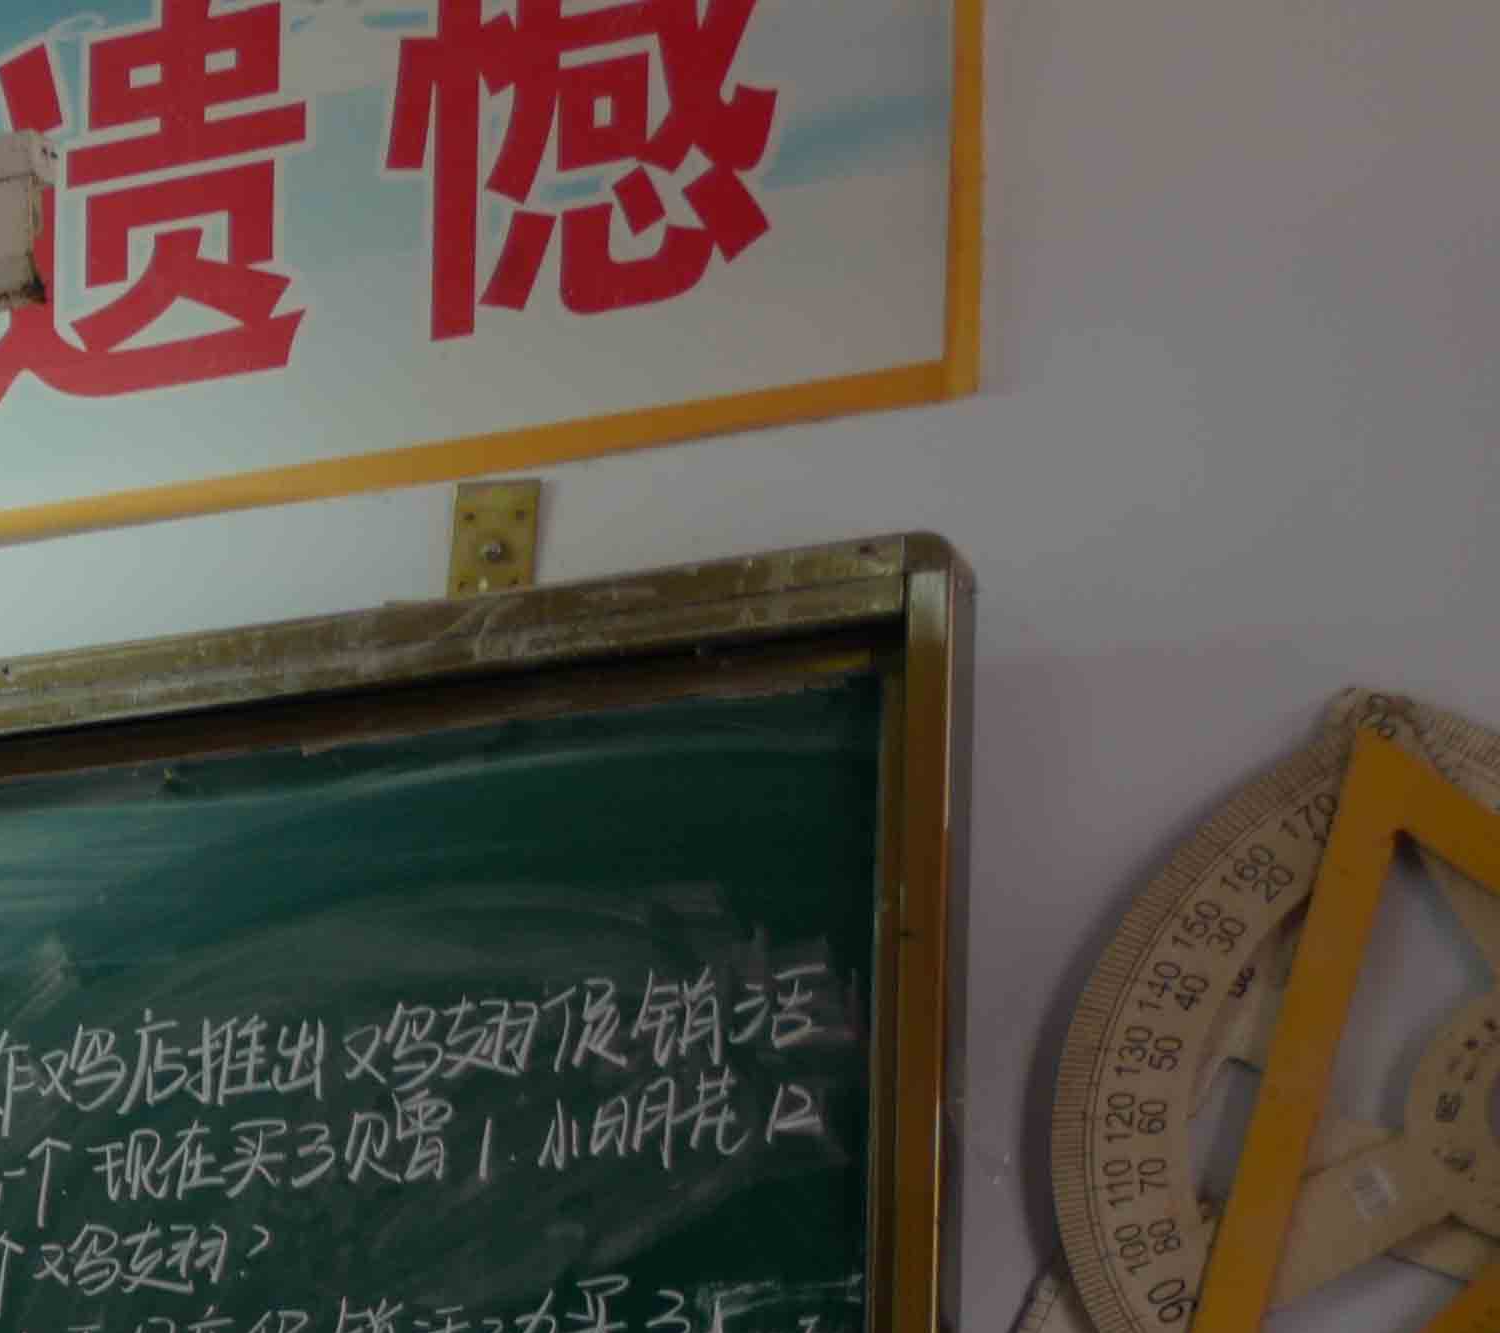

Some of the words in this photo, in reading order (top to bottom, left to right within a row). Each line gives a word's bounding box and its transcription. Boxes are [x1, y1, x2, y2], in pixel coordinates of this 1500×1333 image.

[1173, 902, 1221, 949] 150
[1206, 917, 1246, 953] 30
[1140, 961, 1180, 1012] 140
[1115, 1025, 1154, 1076] 130
[1148, 1036, 1185, 1073] 50
[1104, 1092, 1136, 1142] 120
[1139, 1099, 1168, 1135] 60
[1104, 1158, 1133, 1208] 110
[1138, 1157, 1166, 1193] 70
[1114, 1222, 1148, 1273] 100
[1148, 1218, 1180, 1256] 80
